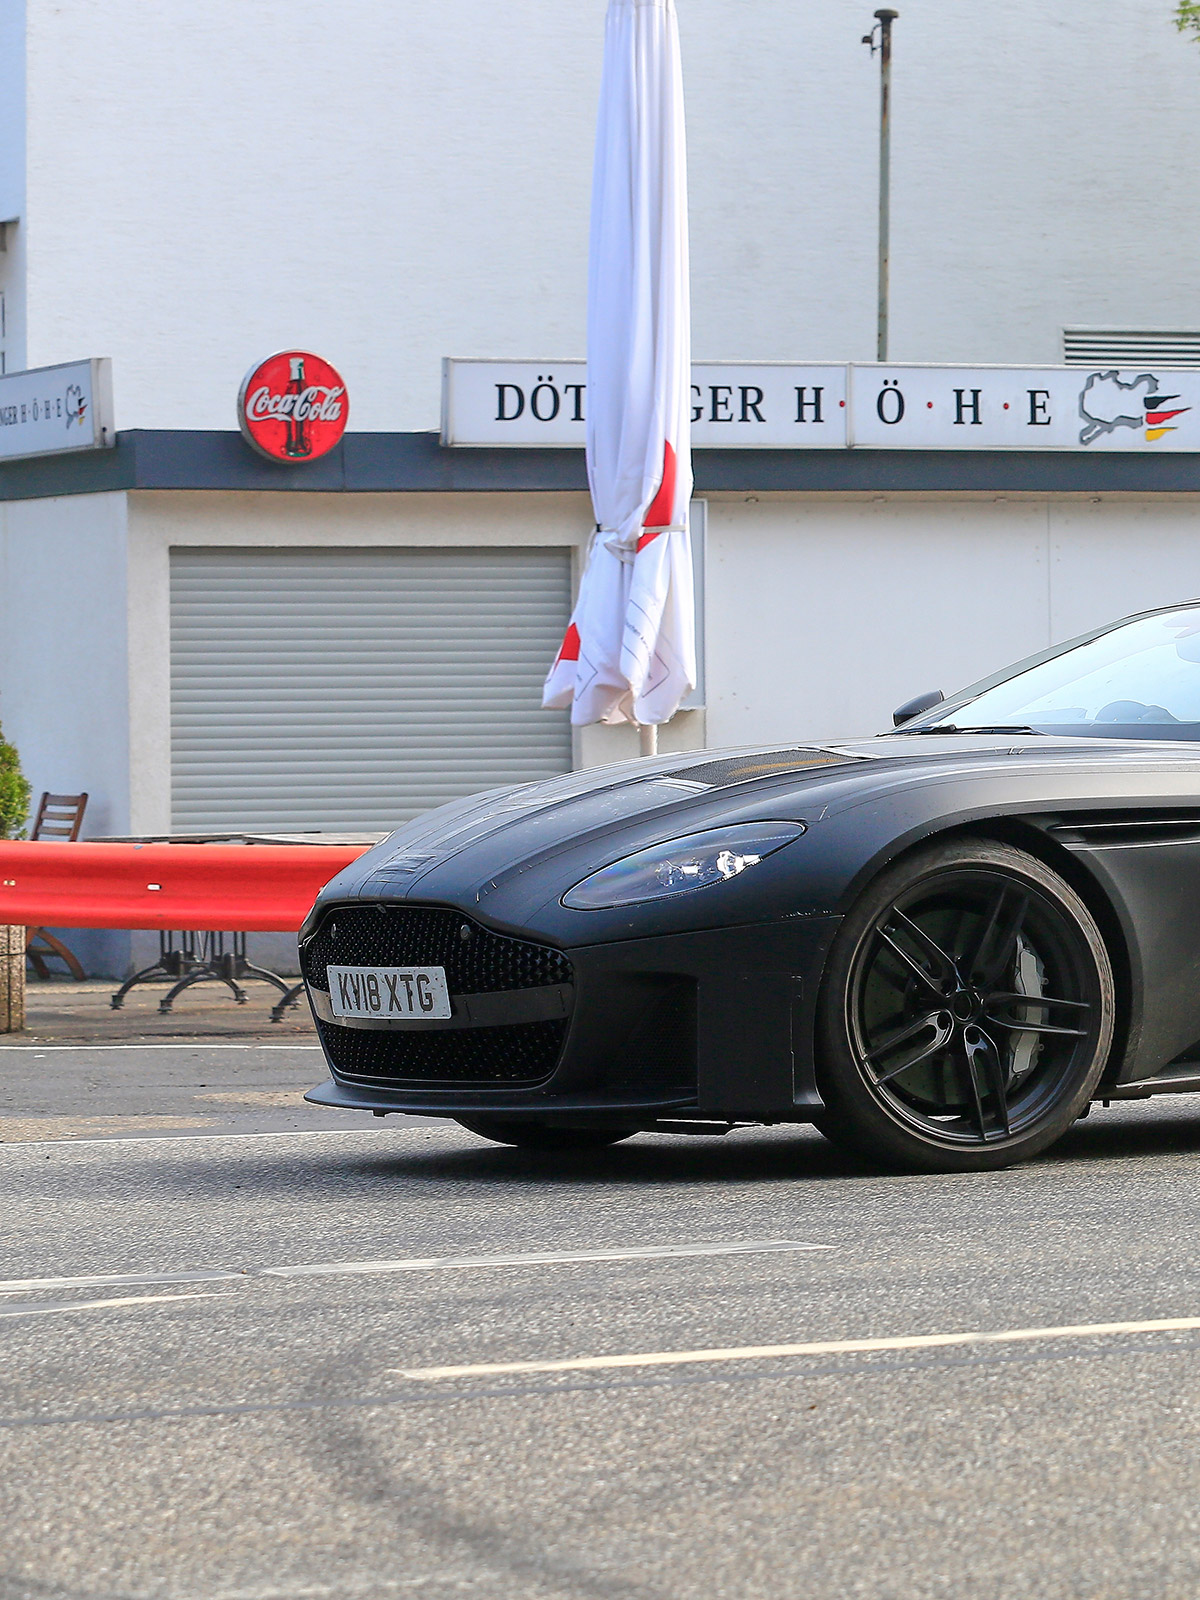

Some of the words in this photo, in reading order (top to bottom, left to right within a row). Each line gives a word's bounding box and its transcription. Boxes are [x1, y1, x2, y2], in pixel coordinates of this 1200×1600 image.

[245, 386, 345, 422] Coca-Cola
[494, 374, 767, 423] DÖTGER
[337, 972, 381, 1012] KV18
[384, 973, 434, 1012] XTG
